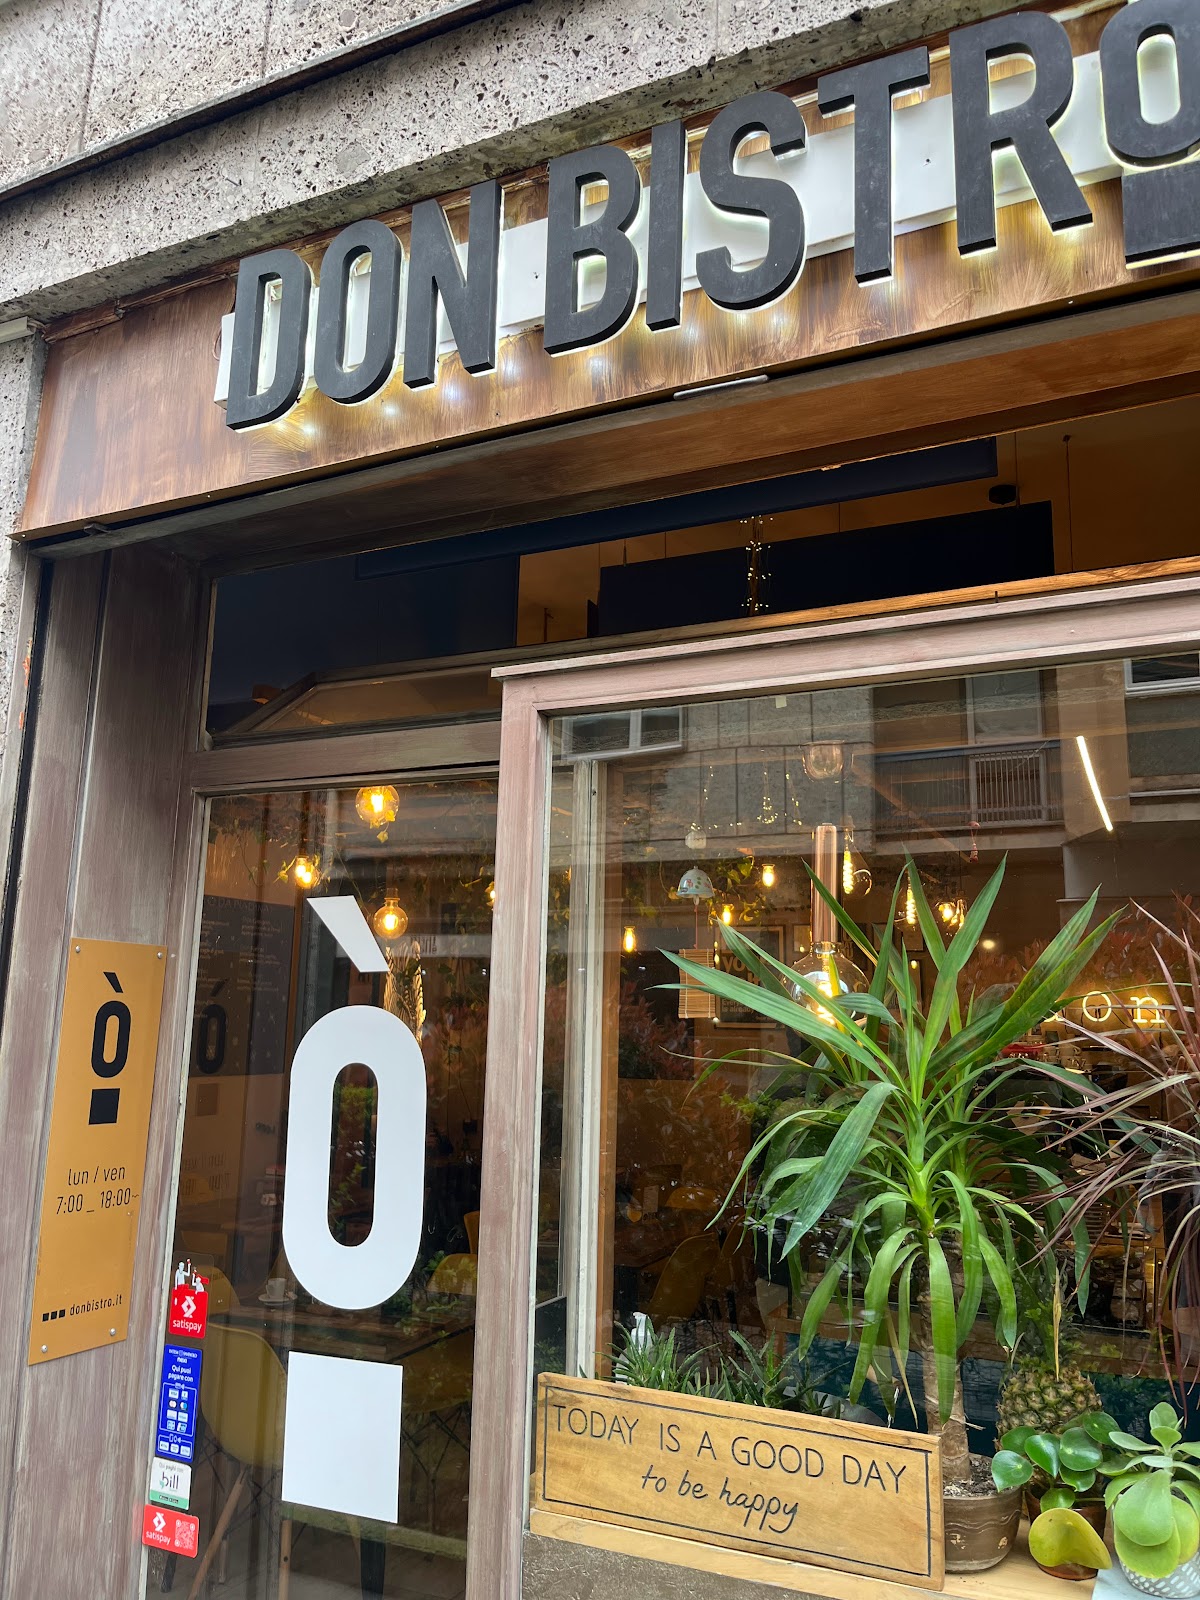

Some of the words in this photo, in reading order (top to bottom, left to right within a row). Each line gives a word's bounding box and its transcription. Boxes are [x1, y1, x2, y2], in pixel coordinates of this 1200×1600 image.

[226, 178, 503, 430] DON
[68, 1168, 89, 1186] lun
[103, 1166, 126, 1182] ven
[56, 1194, 83, 1215] 7:00
[69, 1294, 123, 1316] donbistro.it
[172, 1319, 202, 1333] satispay
[168, 1373, 185, 1381] pagare
[171, 1364, 181, 1373] Qui
[552, 1404, 639, 1445] TODAY
[659, 1422, 681, 1453] IS
[696, 1430, 717, 1460] A
[731, 1436, 825, 1478] GOOD
[842, 1455, 907, 1494] DAY
[159, 1471, 179, 1489] bill
[641, 1464, 667, 1493] to
[678, 1469, 708, 1499] be
[719, 1476, 799, 1533] happy
[145, 1530, 171, 1546] satispay
